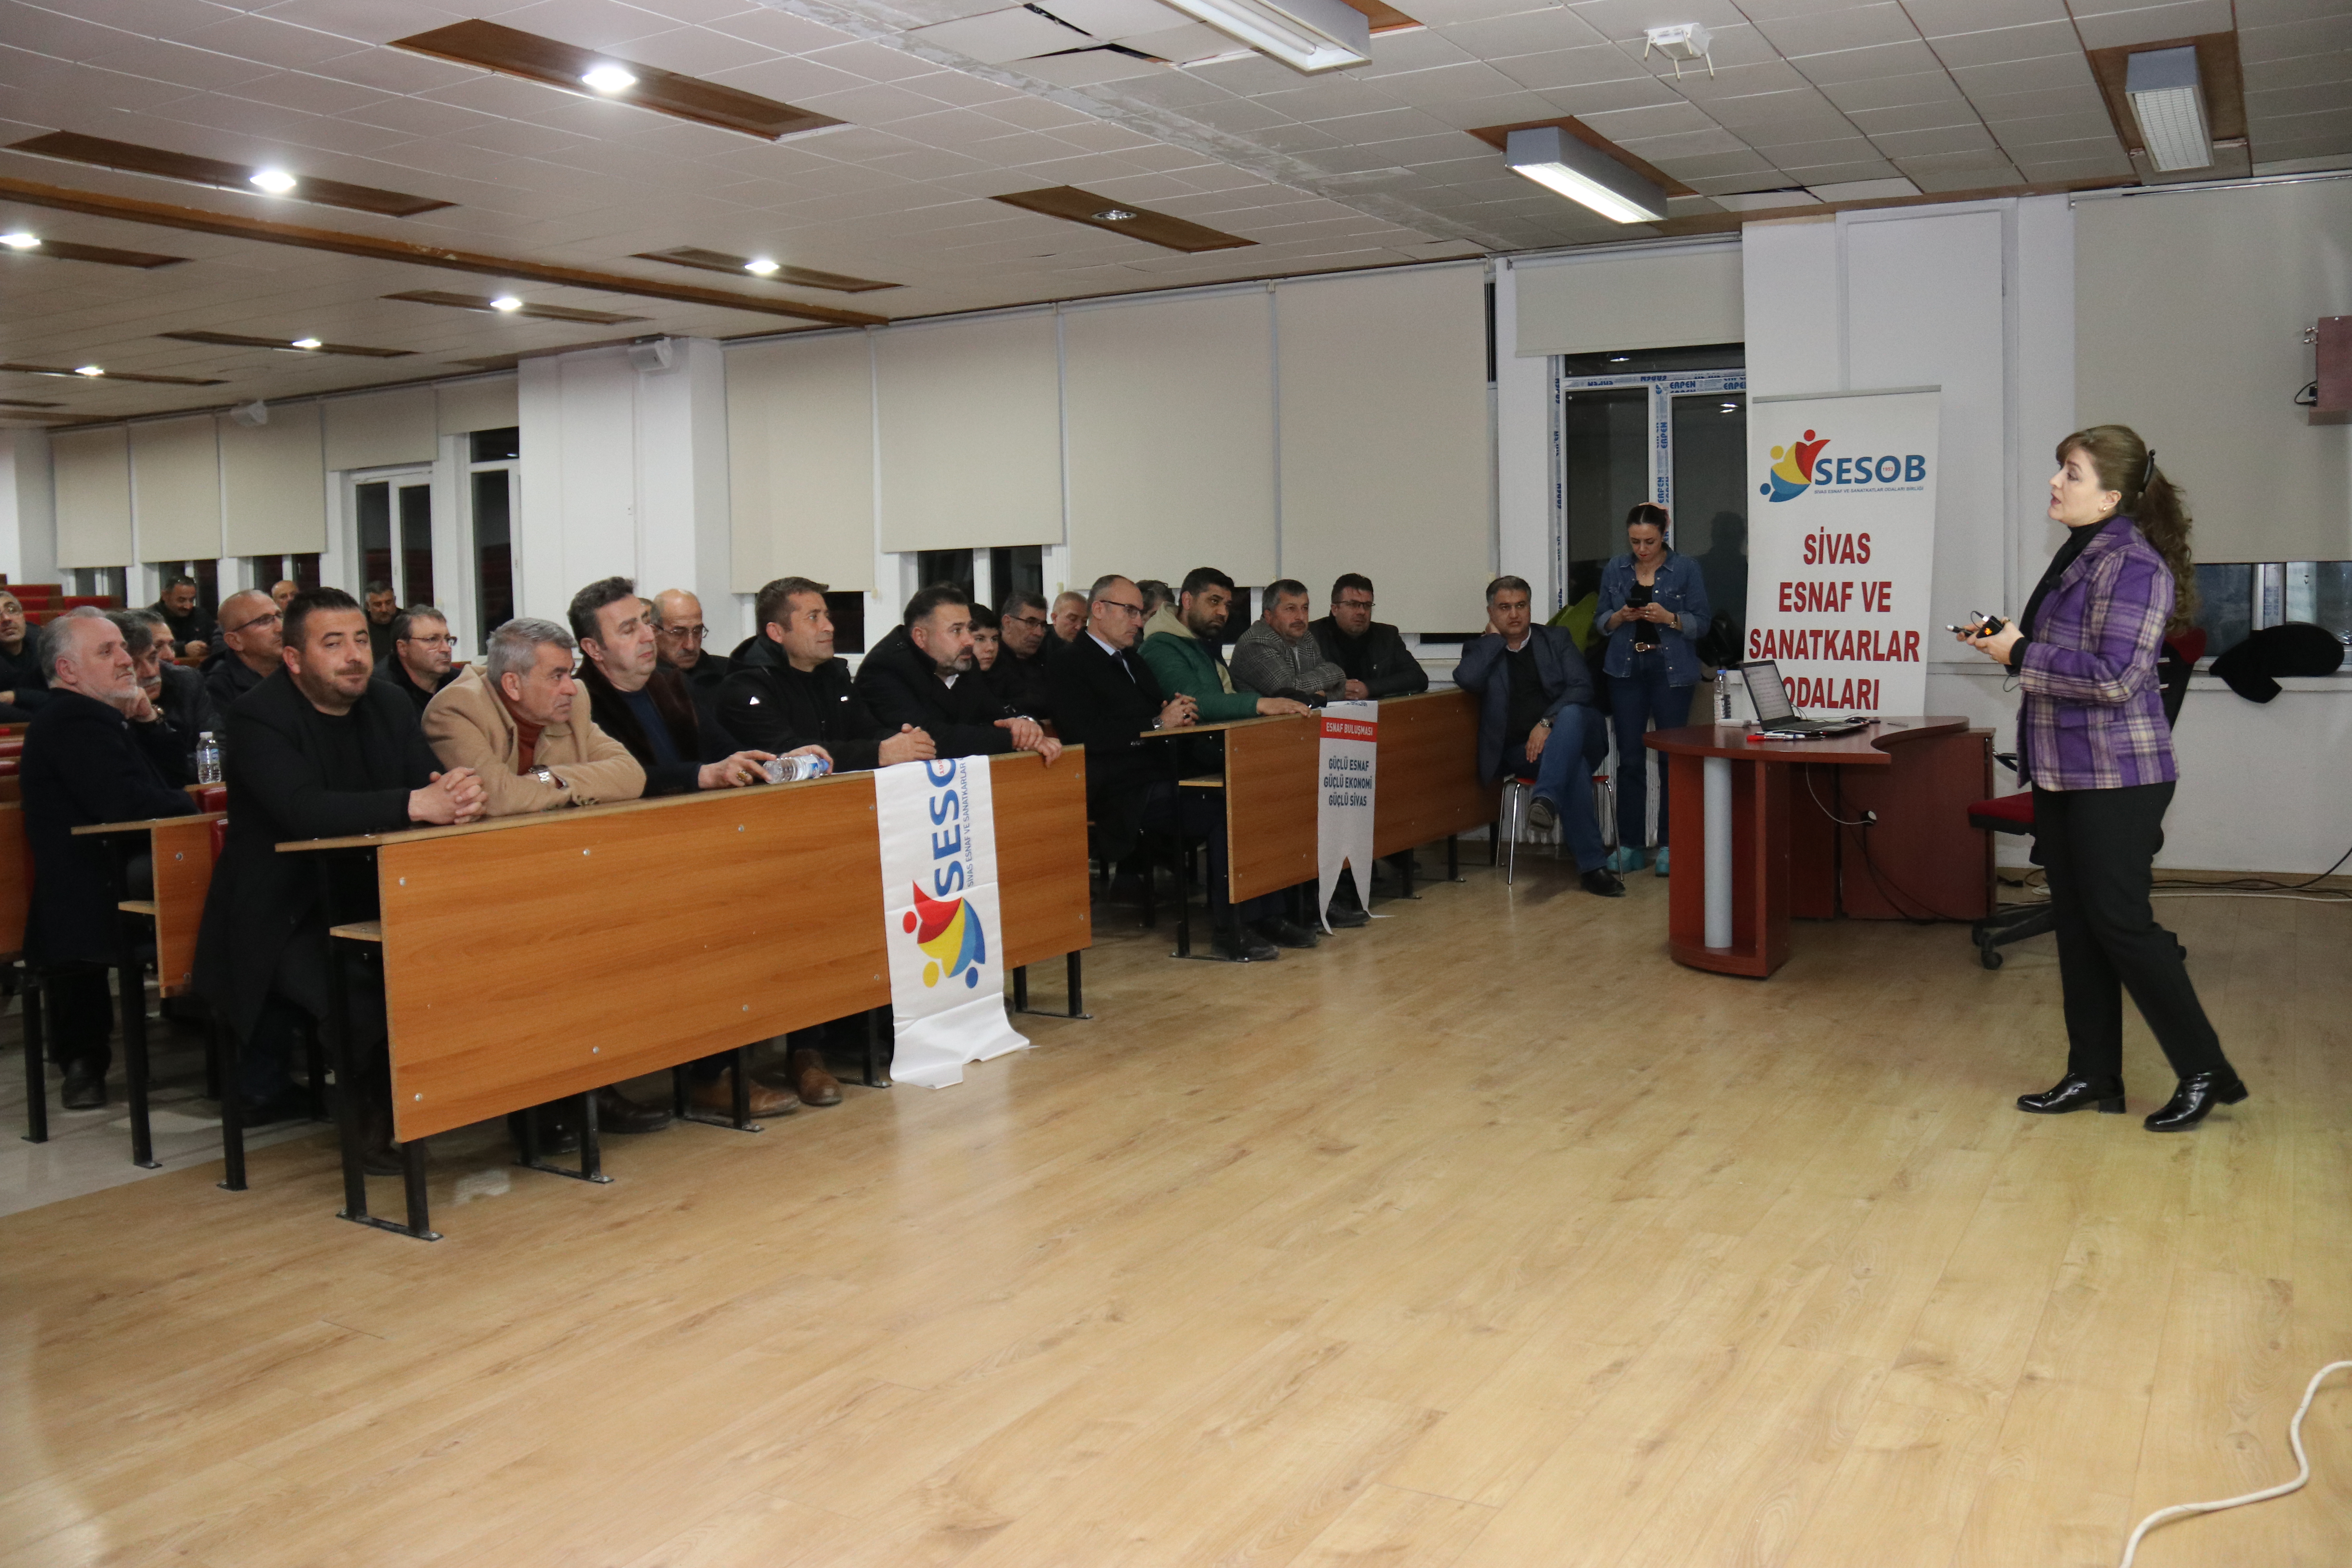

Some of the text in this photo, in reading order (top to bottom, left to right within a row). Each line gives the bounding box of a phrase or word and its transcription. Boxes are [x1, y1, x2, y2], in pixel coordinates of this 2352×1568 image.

[1815, 455, 1926, 485] SESOB
[1803, 526, 1870, 565] SİVAS
[1779, 581, 1892, 613] ESNAF VE
[1749, 628, 1919, 662] SANATKARLAR
[1782, 677, 1880, 710] ODALARI
[1326, 722, 1373, 736] ESNAF BULUŞMASI
[1329, 755, 1369, 771] GÜÇLÜ ESNAF
[960, 762, 969, 822] SANATKARLAR
[1324, 773, 1372, 789] GÜÇLÜ EKONOMİ
[1329, 792, 1367, 808] GÜÇLÜ SİVAS
[963, 823, 970, 834] VE
